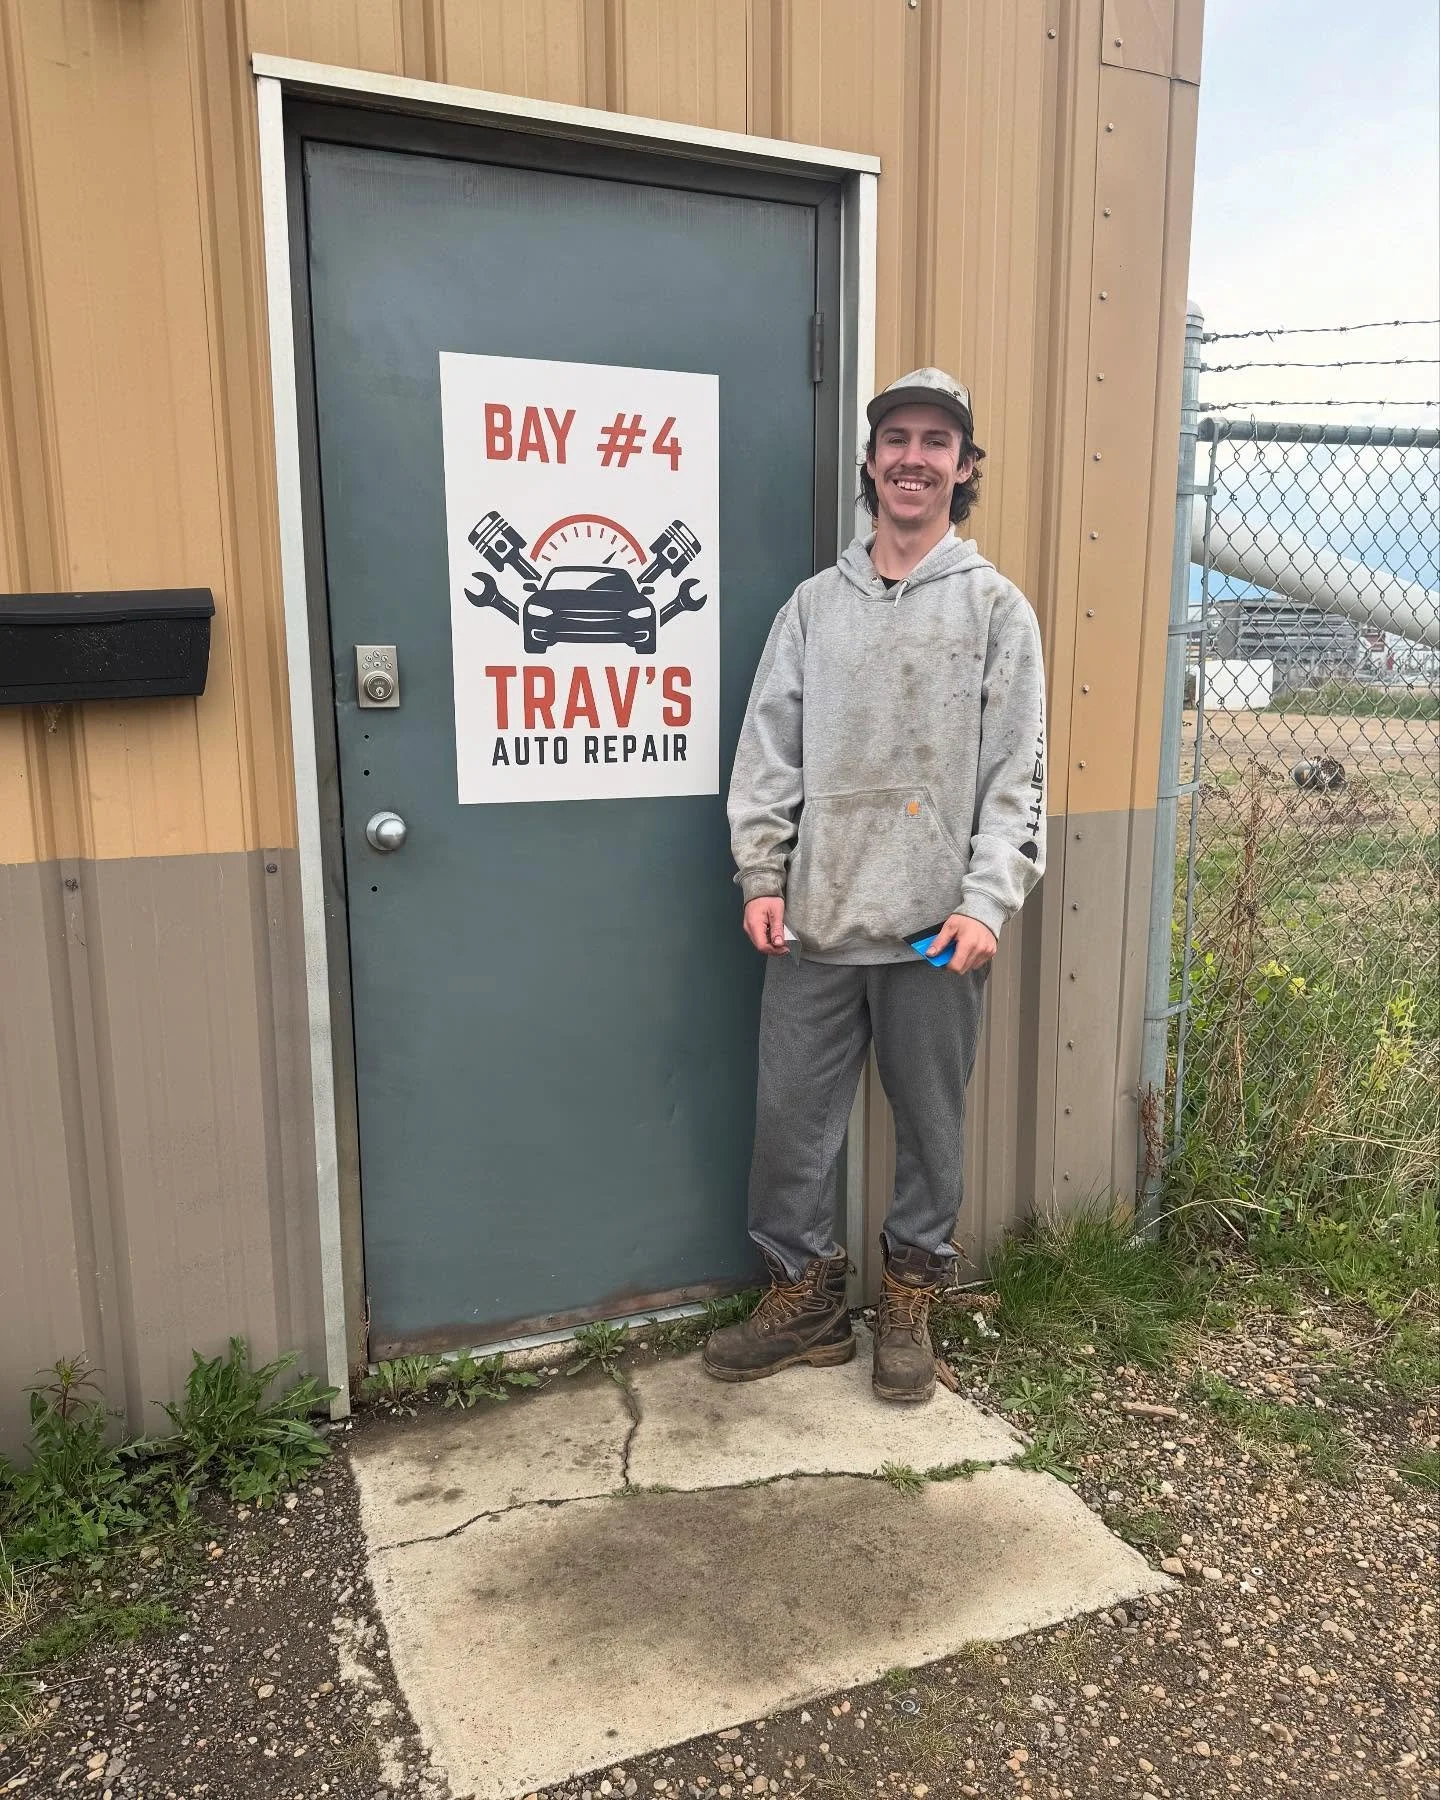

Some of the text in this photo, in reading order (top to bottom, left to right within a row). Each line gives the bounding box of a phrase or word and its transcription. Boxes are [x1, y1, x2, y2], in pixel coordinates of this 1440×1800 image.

[485, 403, 682, 471] BAY #4
[485, 665, 692, 730] TRAV'S
[491, 733, 687, 767] AUTO REPAIR
